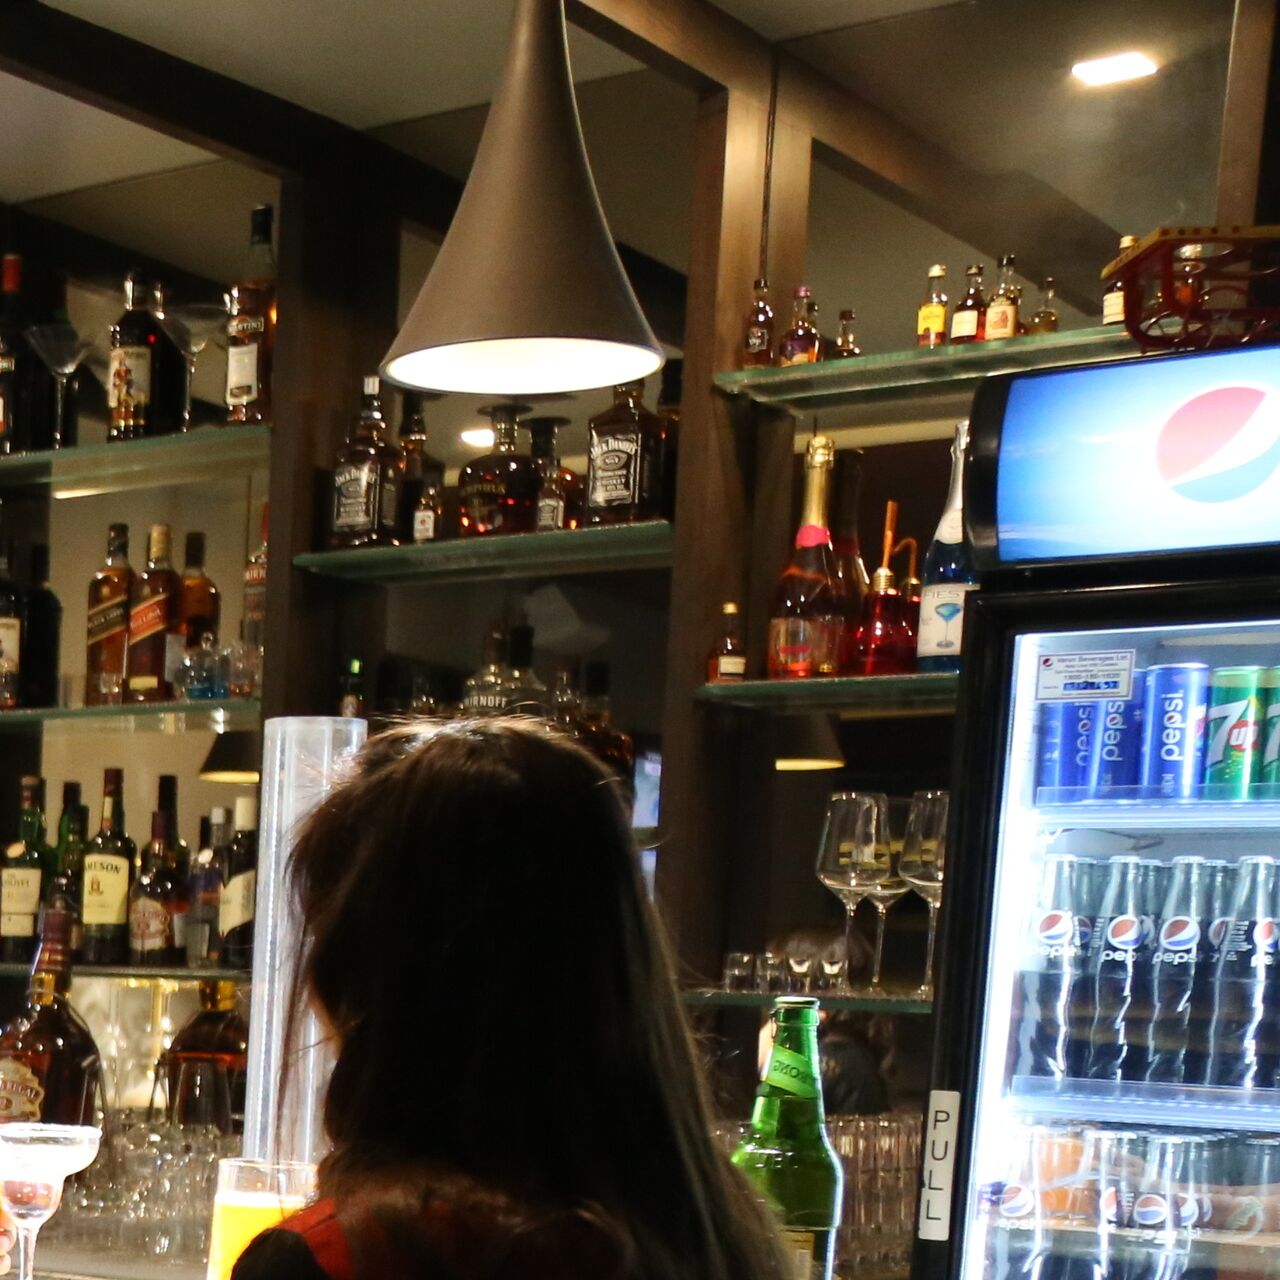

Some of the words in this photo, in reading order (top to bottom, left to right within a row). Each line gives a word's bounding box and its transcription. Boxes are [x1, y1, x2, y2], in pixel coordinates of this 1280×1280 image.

[1101, 701, 1128, 762] peps
[1160, 690, 1188, 761] pepsi
[1205, 699, 1250, 769] 7
[926, 1109, 950, 1221] PULL
